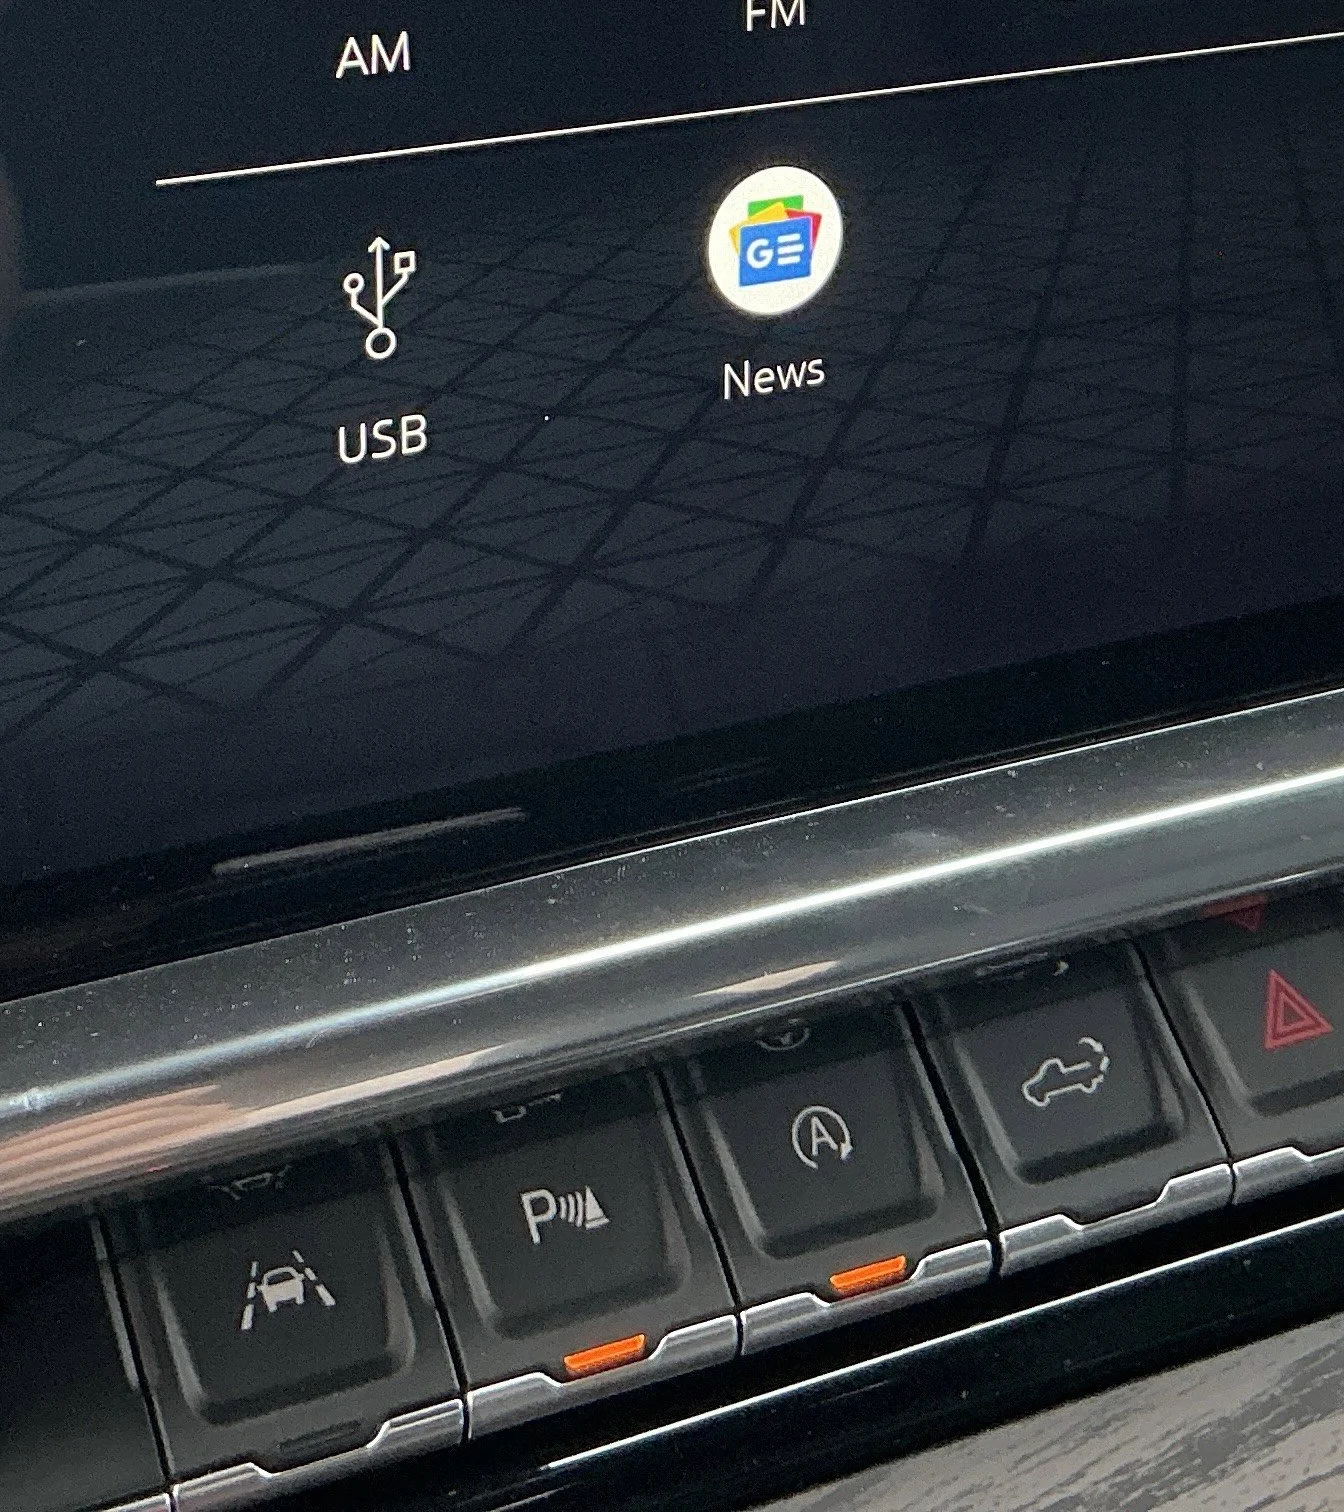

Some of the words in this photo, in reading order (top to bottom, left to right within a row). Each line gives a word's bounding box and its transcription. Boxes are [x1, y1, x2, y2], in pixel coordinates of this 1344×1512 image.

[336, 31, 411, 79] AM
[723, 358, 826, 401] News
[338, 414, 427, 465] USB
[520, 1188, 556, 1245] P
